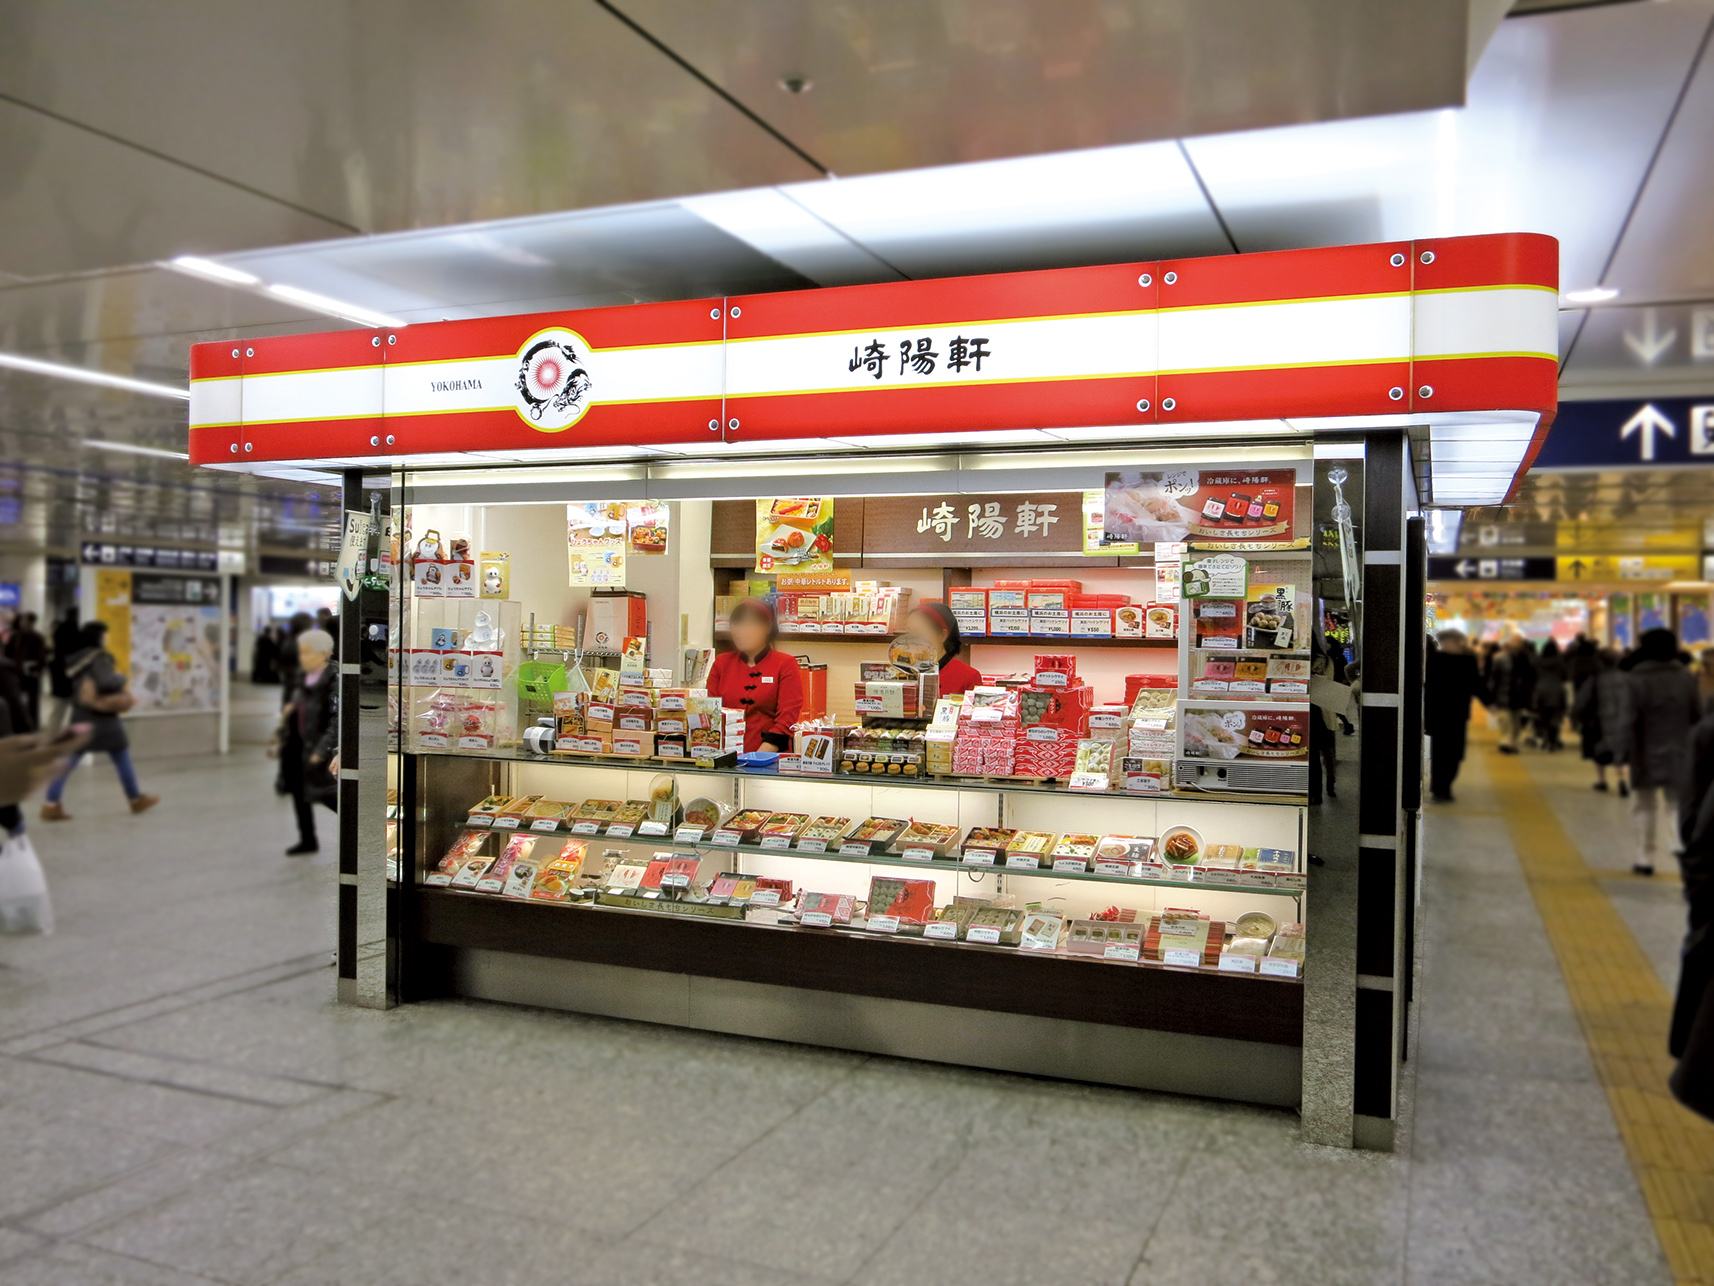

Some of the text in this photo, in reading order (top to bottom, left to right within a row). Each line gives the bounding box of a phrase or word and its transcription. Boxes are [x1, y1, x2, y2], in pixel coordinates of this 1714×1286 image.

[849, 335, 992, 380] 崎陽軒
[431, 379, 482, 392] YOKOHAMA
[916, 500, 1060, 542] 崎陽軒
[1198, 527, 1277, 537] おいしさ長もちシリーズ
[625, 898, 714, 914] おいしさ長もちシリーズ
